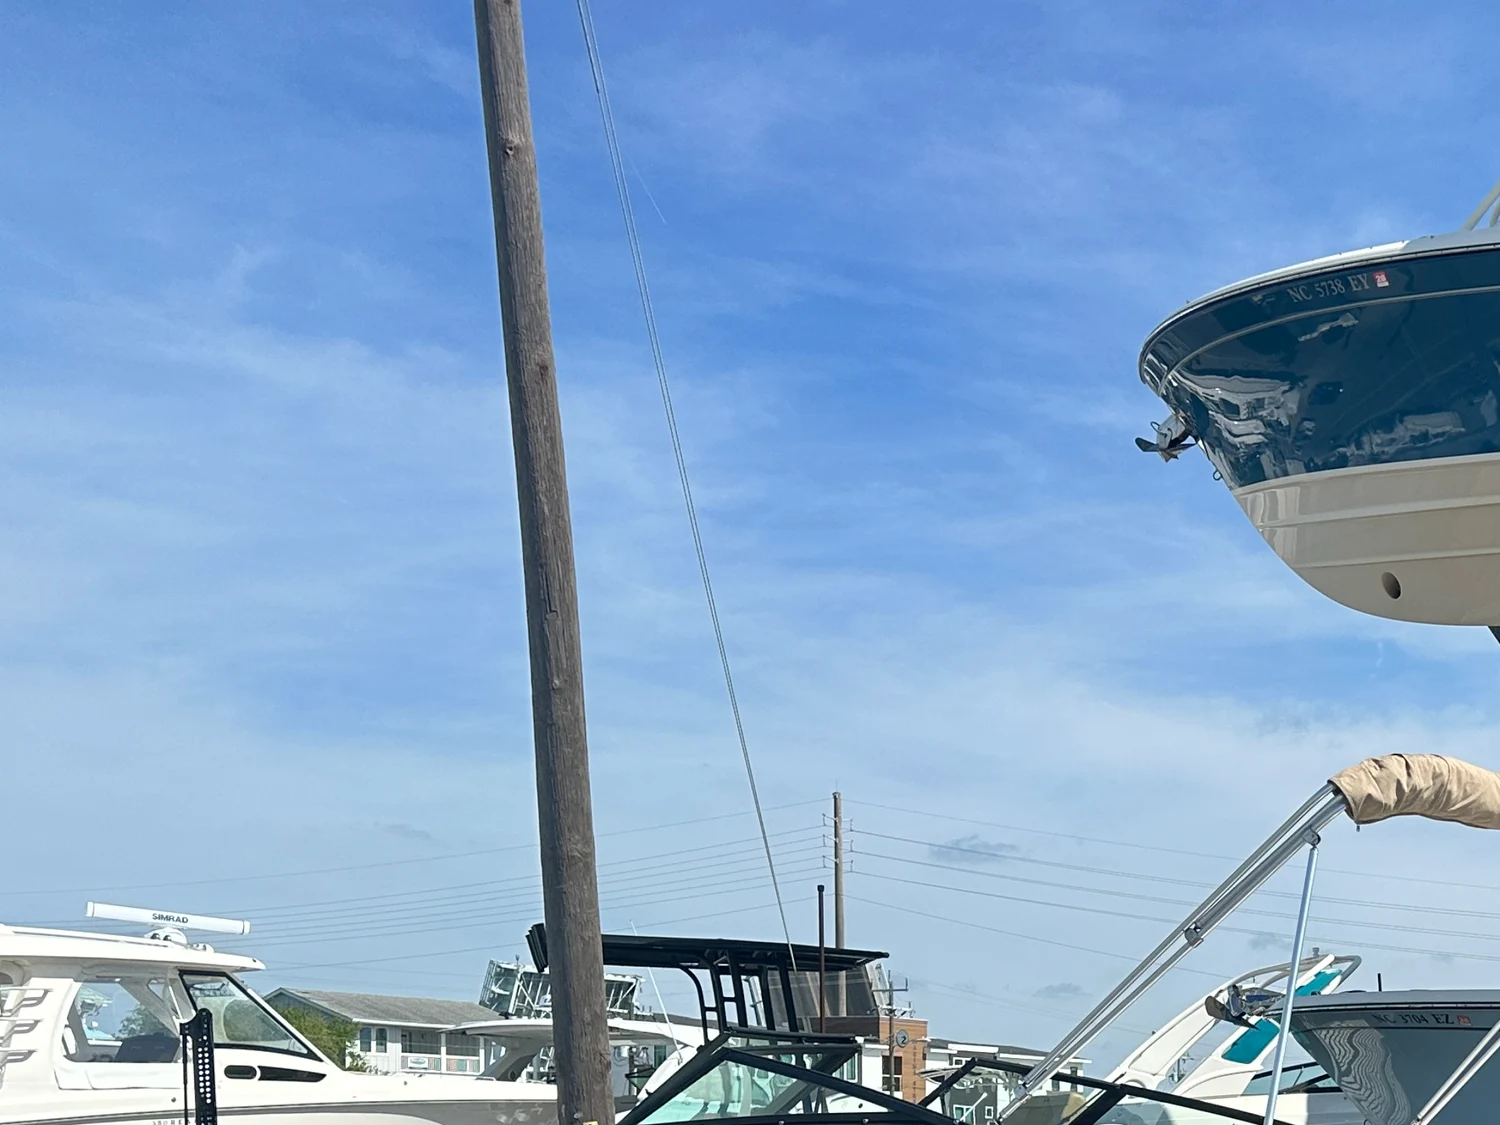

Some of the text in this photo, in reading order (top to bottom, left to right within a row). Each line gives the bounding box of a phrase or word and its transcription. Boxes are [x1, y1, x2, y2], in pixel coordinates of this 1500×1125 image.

[1287, 285, 1313, 303] NC
[1348, 273, 1370, 292] EY
[152, 912, 189, 924] SIMRAD
